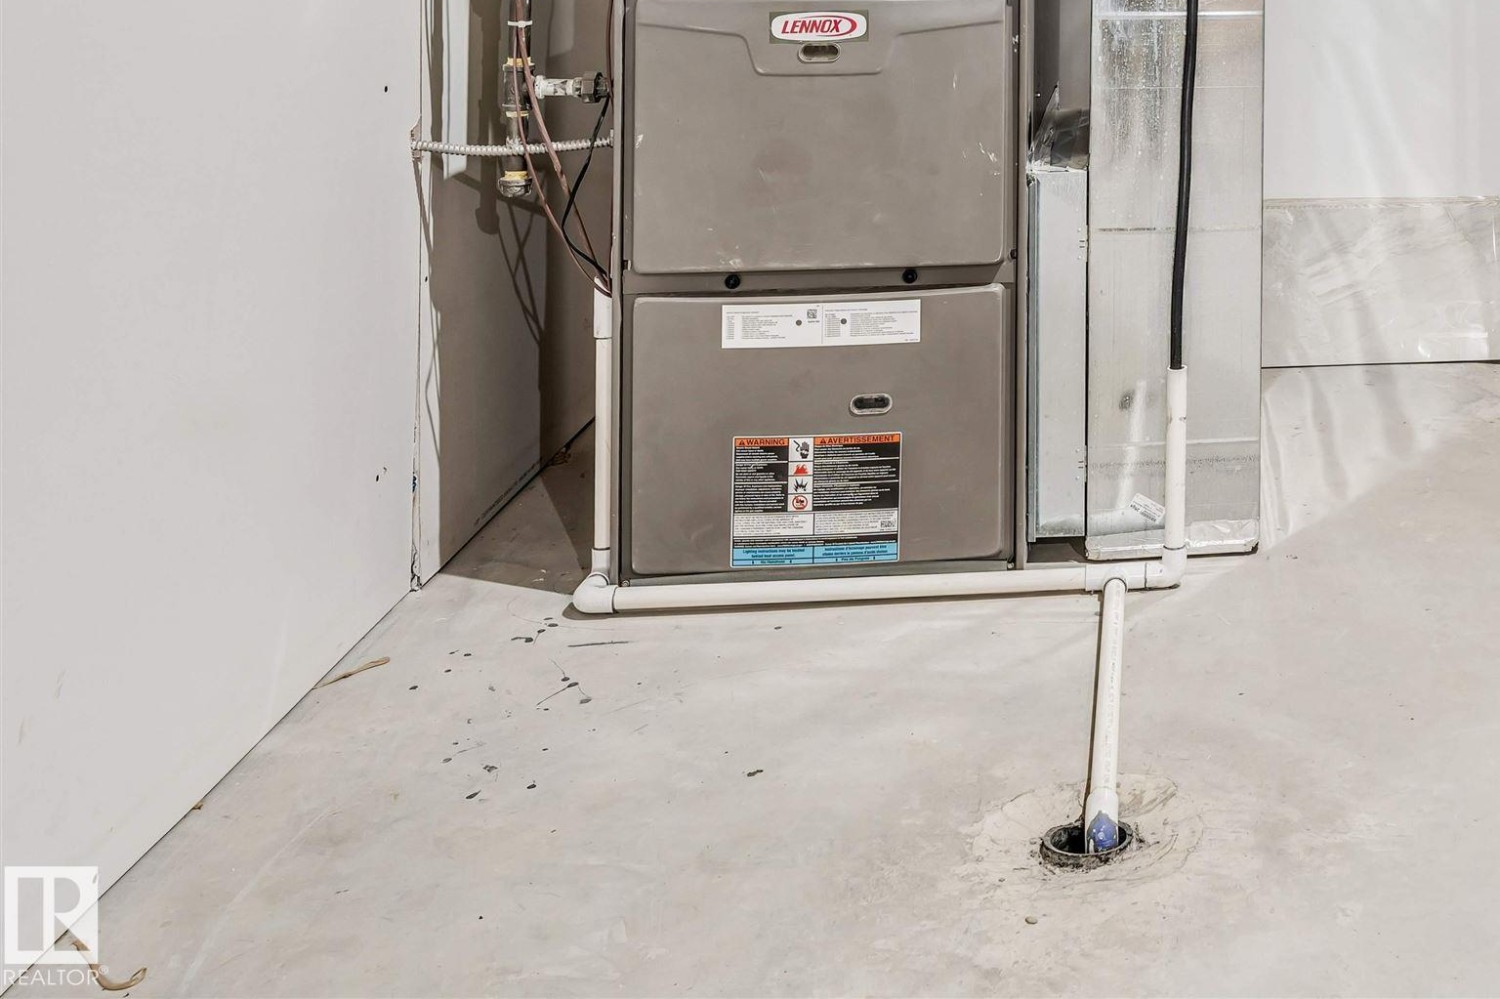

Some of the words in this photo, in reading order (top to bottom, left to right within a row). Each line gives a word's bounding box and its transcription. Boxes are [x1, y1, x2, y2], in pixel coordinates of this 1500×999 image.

[781, 19, 842, 35] LENNOX
[746, 438, 786, 447] WARNING
[828, 435, 895, 445] AVERTISSEMENT
